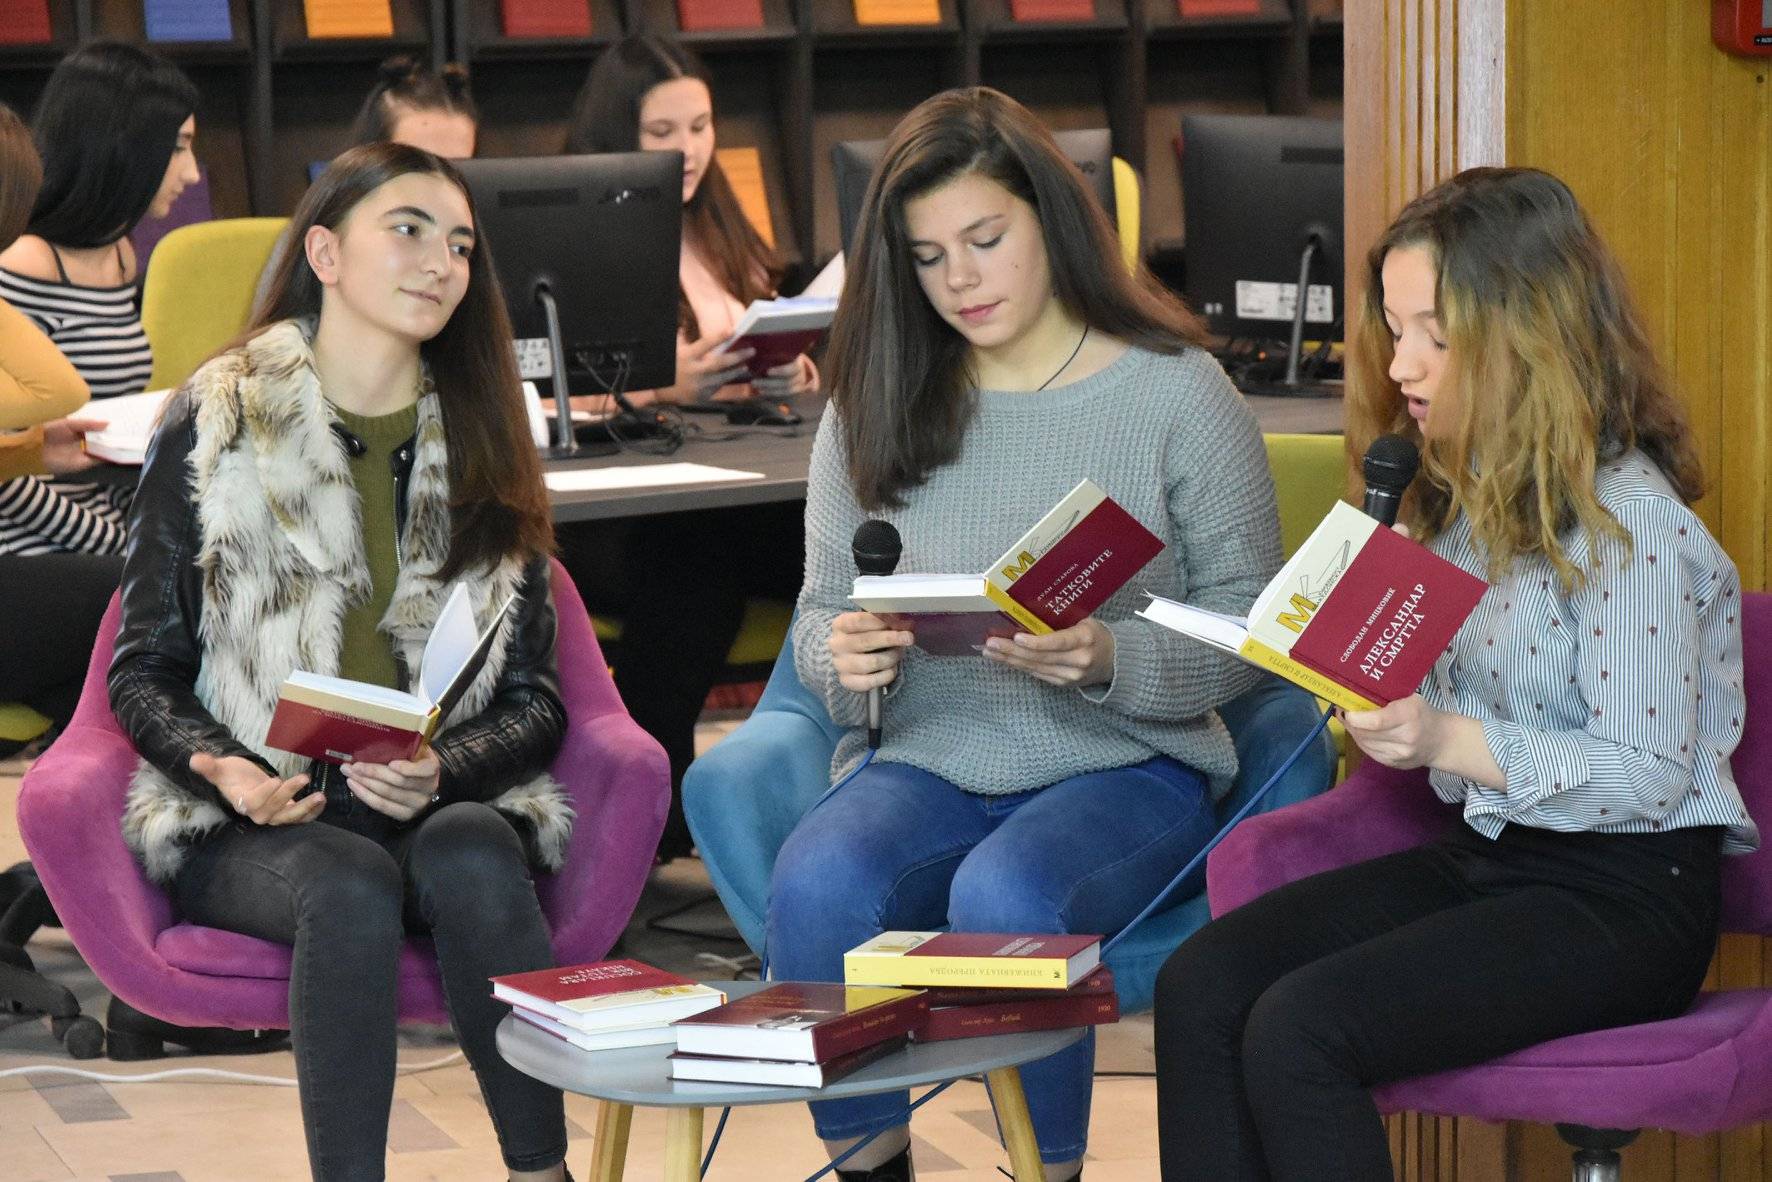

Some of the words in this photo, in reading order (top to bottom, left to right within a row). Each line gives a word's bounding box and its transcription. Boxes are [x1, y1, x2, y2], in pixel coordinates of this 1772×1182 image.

[1045, 548, 1113, 610] ТАТКОВИТЕ
[1053, 578, 1093, 616] КНИГИ
[1340, 626, 1369, 663] СЛОБОДАН
[1360, 583, 1426, 675] АЛЕКСАНДАР
[1369, 667, 1385, 681] И
[1380, 613, 1425, 668] СМРТТА
